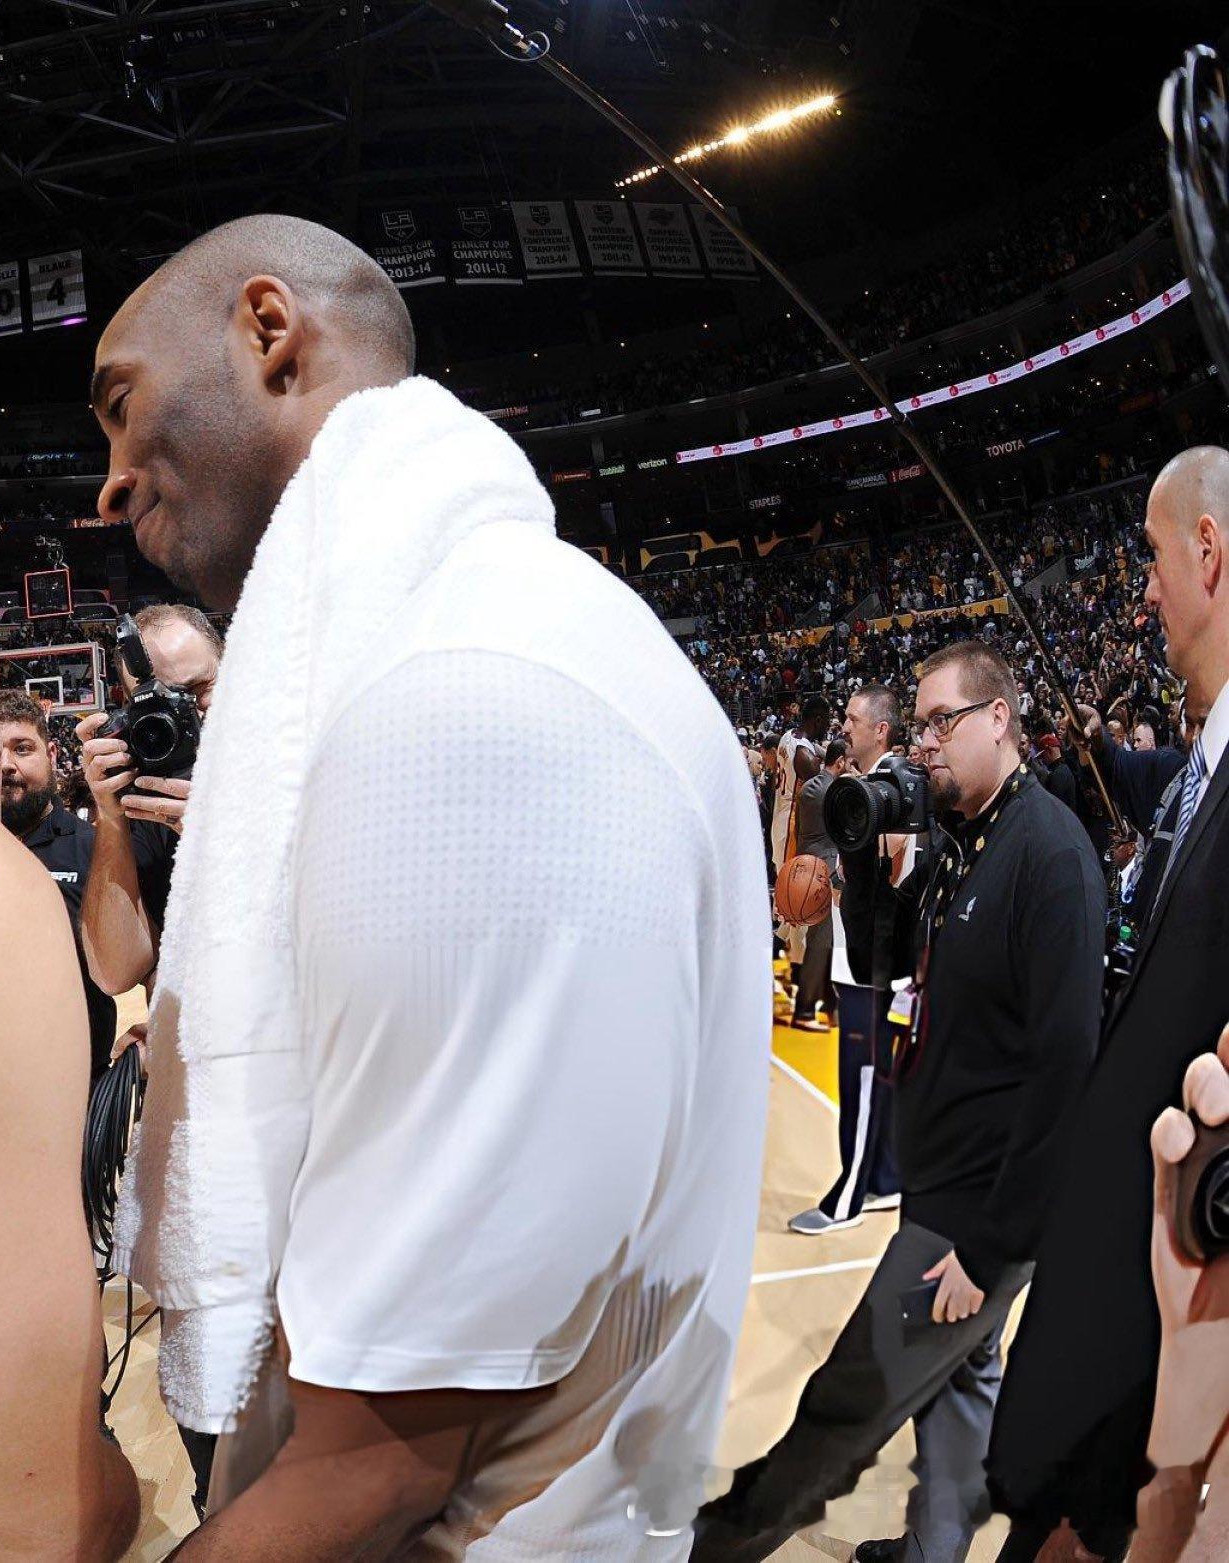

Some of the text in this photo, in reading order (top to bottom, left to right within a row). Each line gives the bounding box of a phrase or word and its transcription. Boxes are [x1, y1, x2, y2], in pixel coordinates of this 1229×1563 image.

[376, 249, 436, 264] CHAMPIONS
[453, 250, 513, 260] CHAMPIONS
[39, 260, 71, 273] BLAKE
[387, 263, 431, 278] 2013-14
[465, 262, 507, 274] 2011-12
[46, 277, 67, 305] 4
[986, 438, 1026, 458] TOYOTA
[638, 459, 668, 469] verizon
[749, 495, 782, 509] STAPLES
